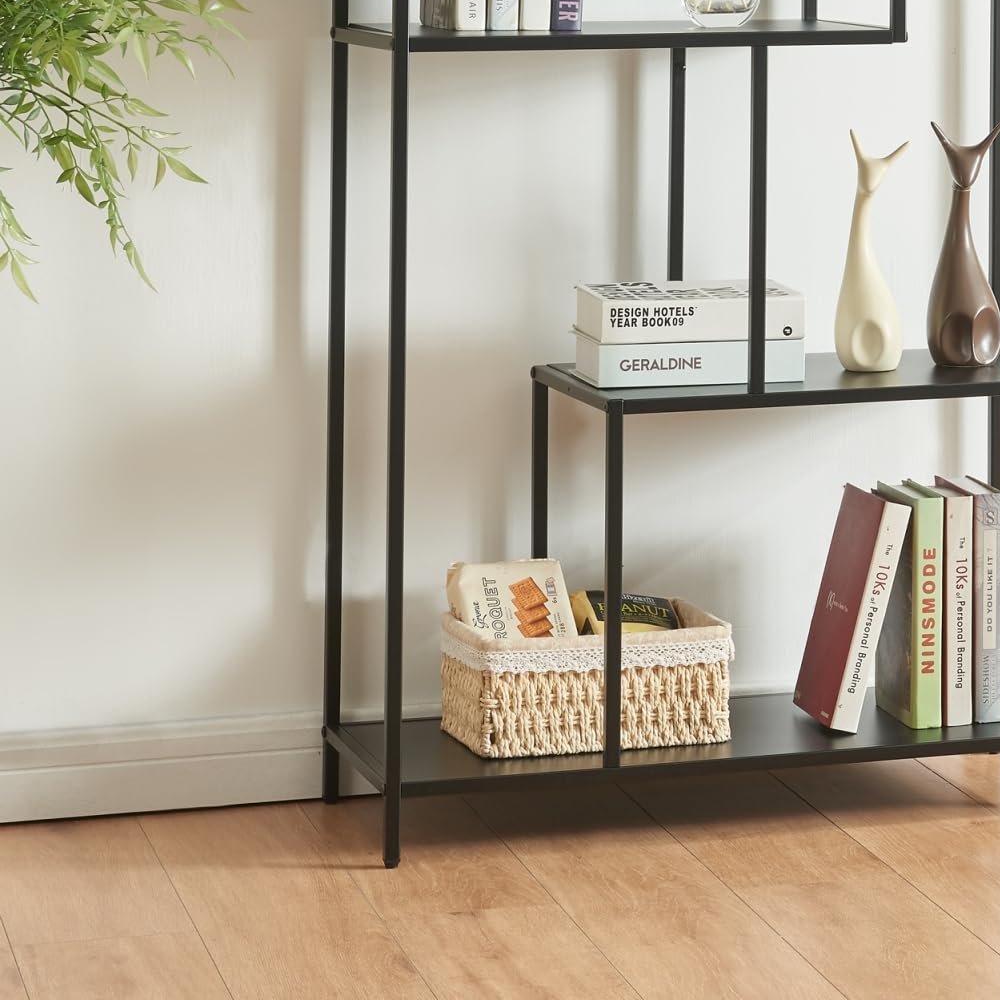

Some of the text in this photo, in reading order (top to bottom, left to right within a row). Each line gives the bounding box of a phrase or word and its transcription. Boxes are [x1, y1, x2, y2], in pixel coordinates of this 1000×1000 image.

[610, 307, 649, 317] DESIGN
[610, 318, 638, 328] YEAR
[620, 357, 702, 372] GERALDINE
[986, 510, 995, 524] S
[987, 556, 993, 566] IT
[956, 558, 968, 590] 10Ks
[597, 602, 669, 618] PANUT
[921, 548, 936, 674] NINSMODE
[848, 543, 893, 694] The 10Ks of Personal Branding
[956, 600, 966, 643] Personal
[986, 617, 993, 632] DO
[955, 647, 966, 689] Branding
[982, 655, 990, 704] SIDESHOW
